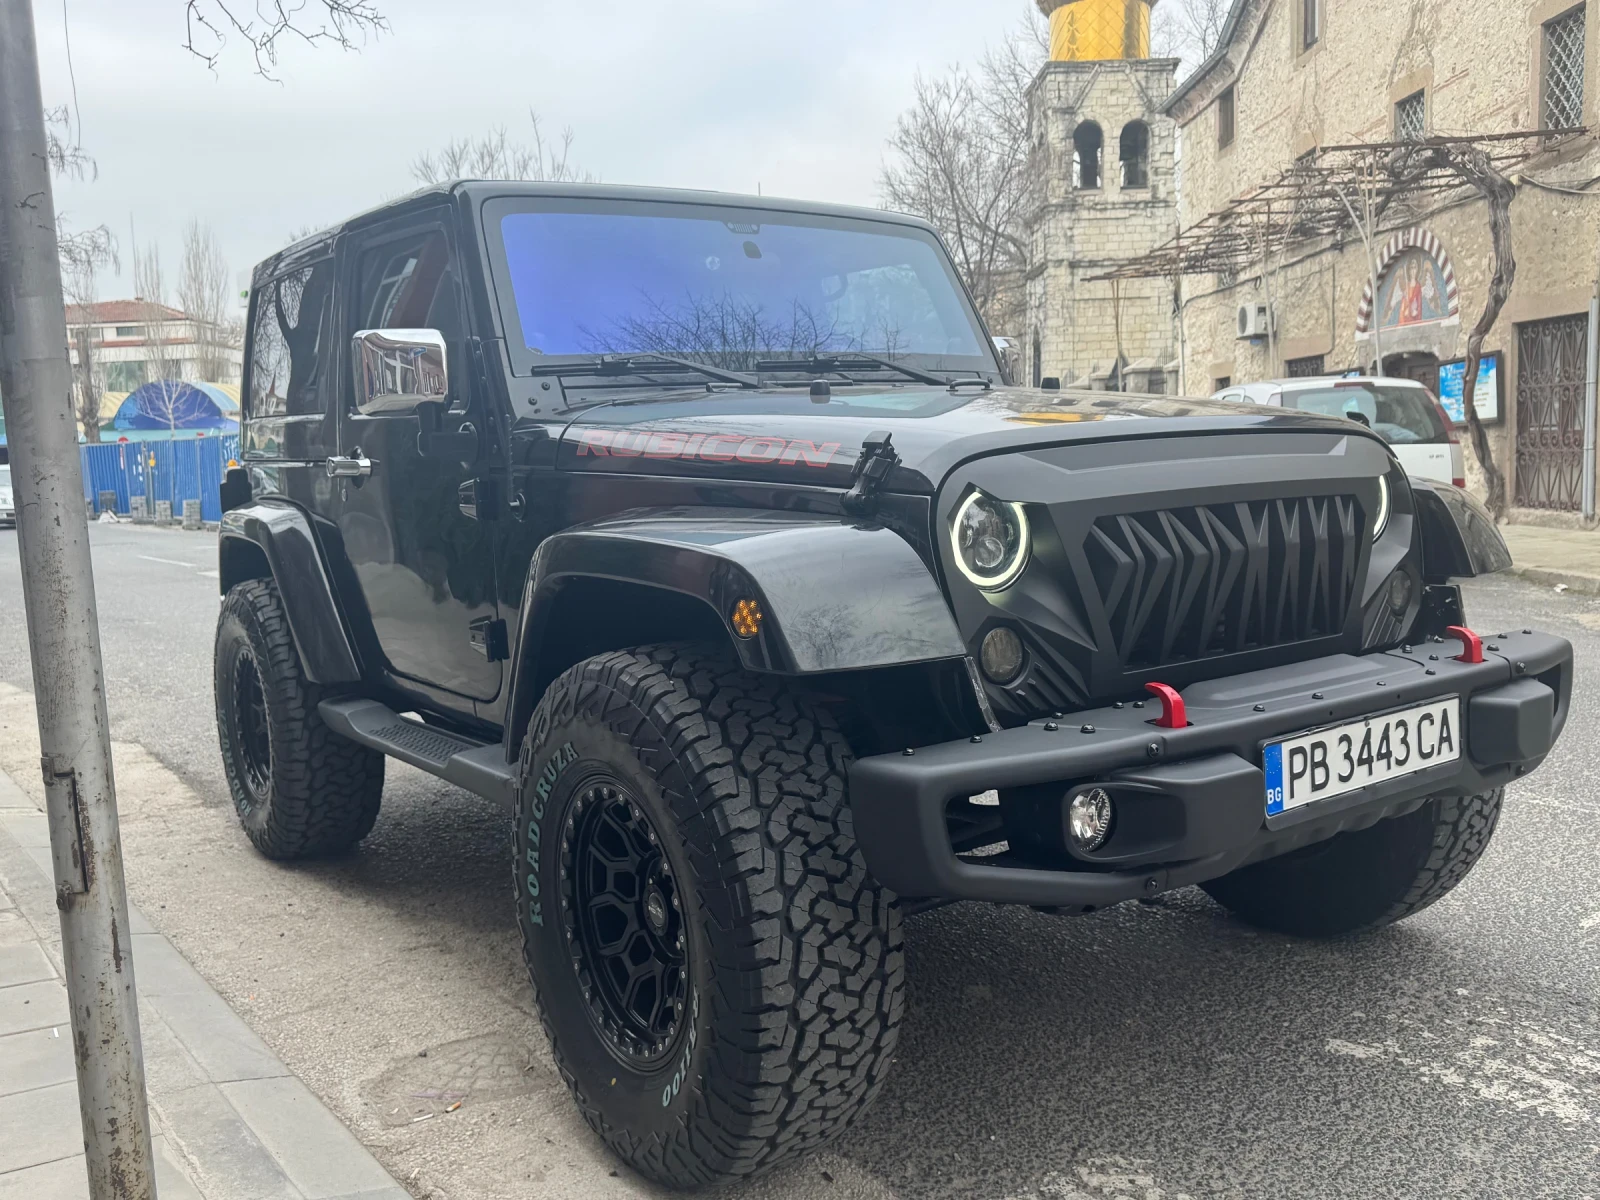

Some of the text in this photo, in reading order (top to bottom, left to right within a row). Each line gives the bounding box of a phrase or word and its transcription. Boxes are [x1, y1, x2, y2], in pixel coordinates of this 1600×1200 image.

[576, 430, 842, 468] RUBICON
[1289, 707, 1454, 800] PB 3443 CA
[1267, 786, 1282, 805] BG
[526, 741, 579, 927] ROADCRUZA
